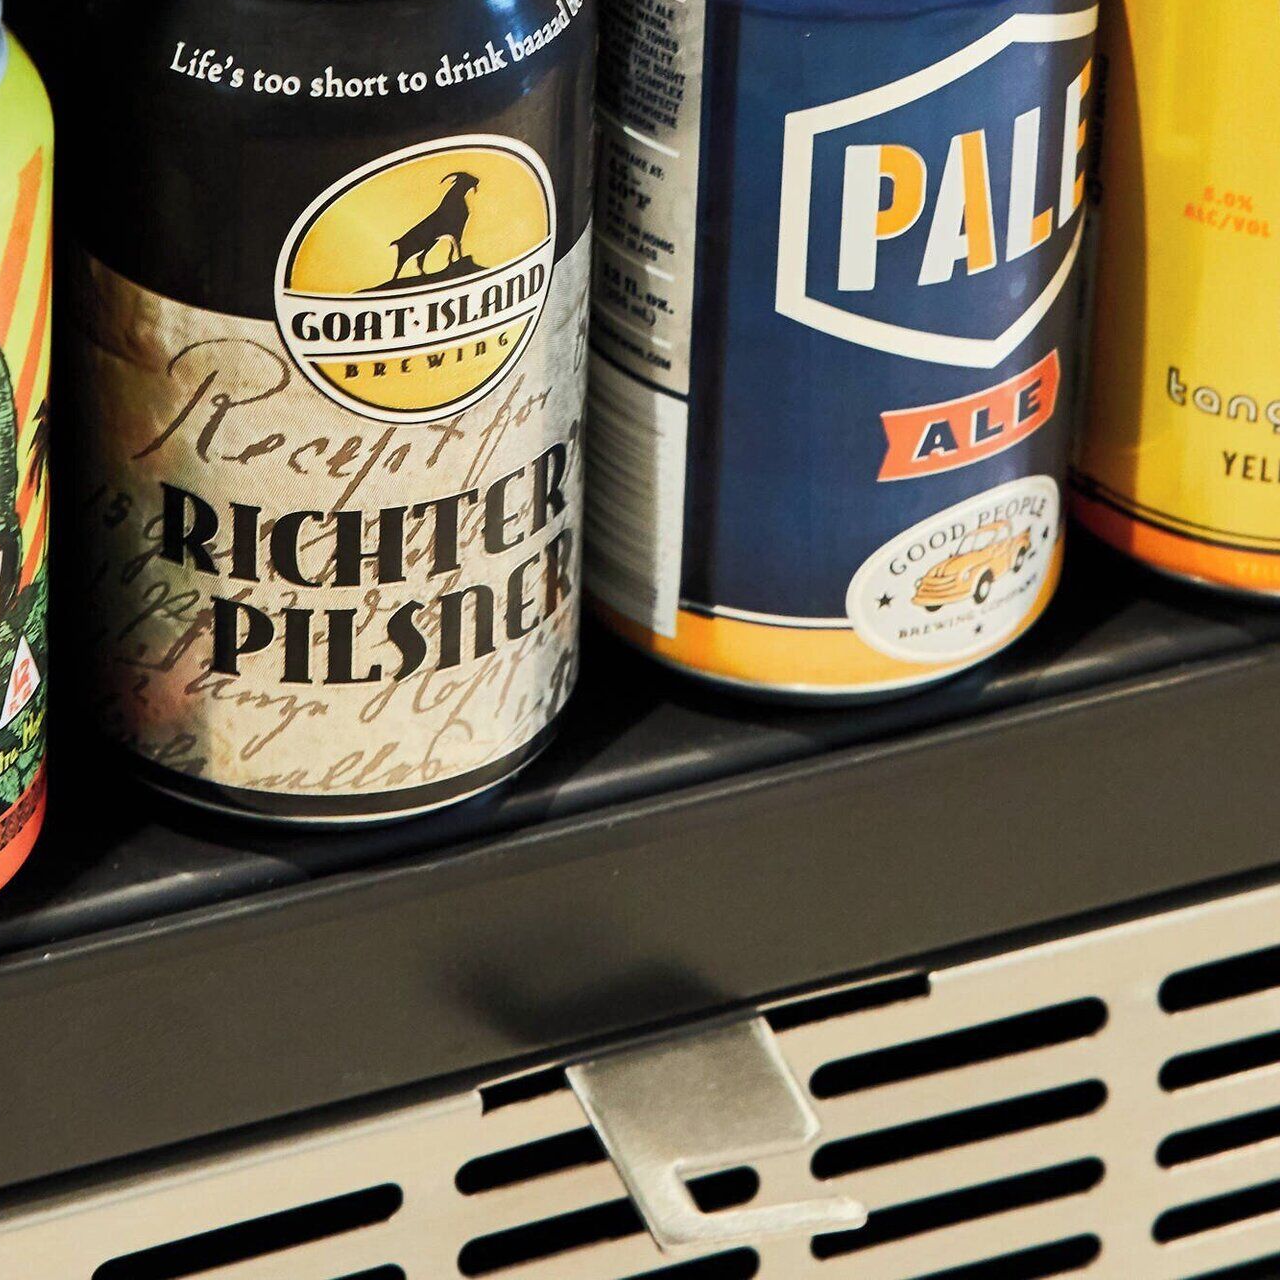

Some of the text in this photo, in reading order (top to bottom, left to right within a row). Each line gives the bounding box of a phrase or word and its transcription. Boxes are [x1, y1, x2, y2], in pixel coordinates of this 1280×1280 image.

[169, 40, 245, 89] Life's
[253, 69, 301, 96] too
[310, 65, 389, 98] short
[397, 70, 428, 94] to
[435, 40, 508, 88] drink
[837, 58, 1093, 292] PALE
[344, 330, 510, 380] BREWING
[911, 379, 1043, 464] ALE
[159, 442, 568, 589] RICHTER
[889, 495, 1048, 576] GOOD PEOPLE
[210, 526, 573, 685] PILSNER
